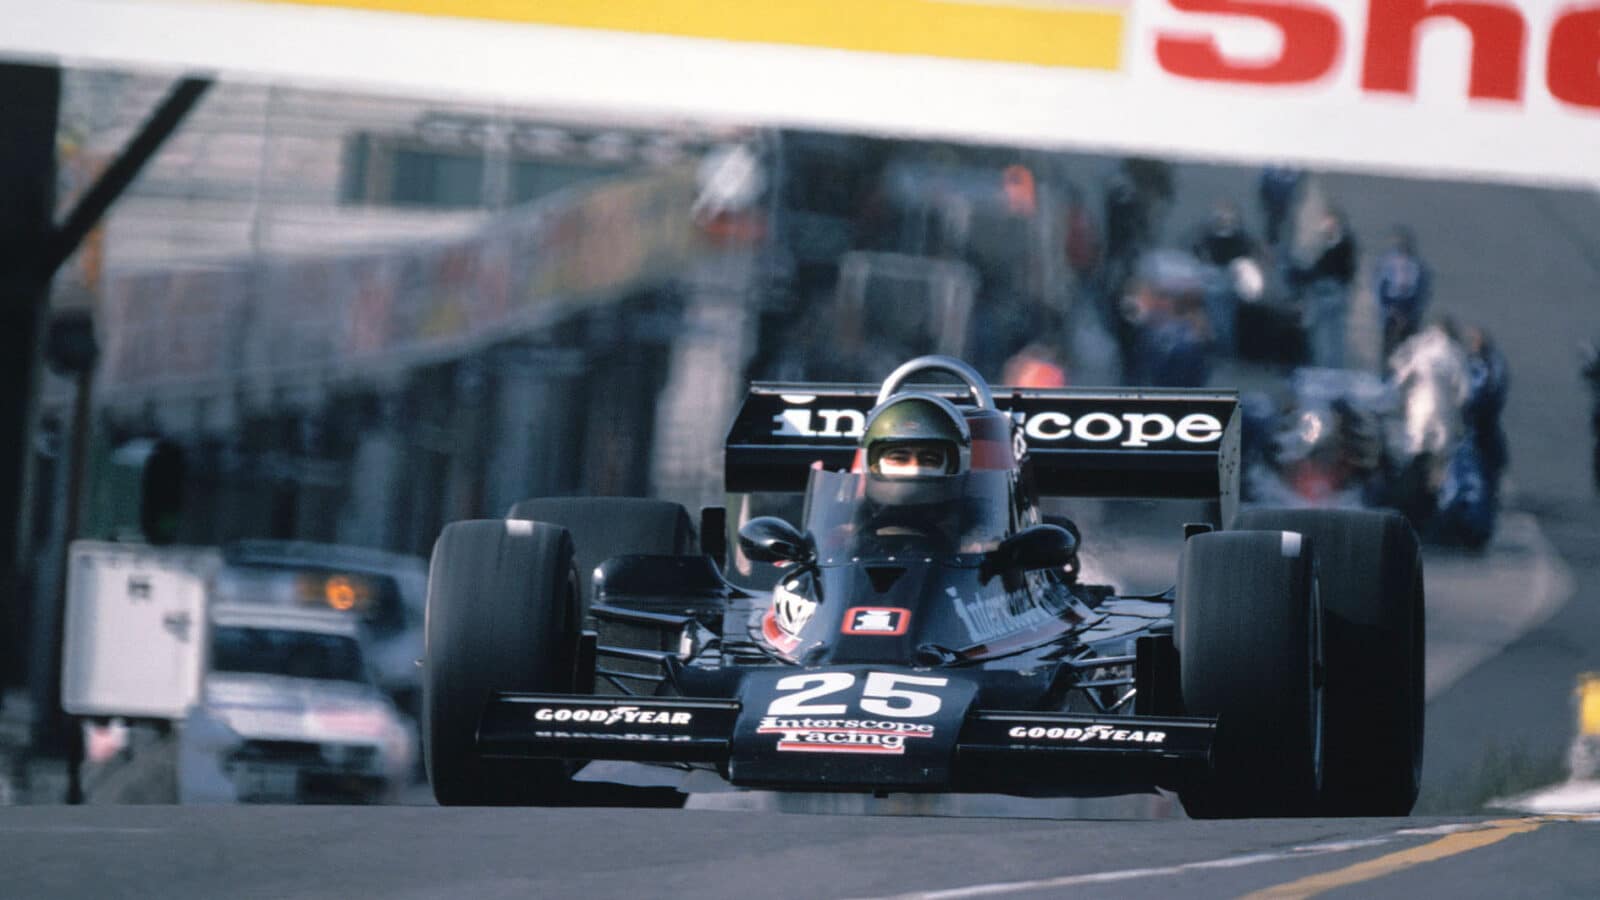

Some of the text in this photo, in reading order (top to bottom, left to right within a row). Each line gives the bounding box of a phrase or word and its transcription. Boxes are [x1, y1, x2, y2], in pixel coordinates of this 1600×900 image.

[771, 394, 1223, 446] incope
[767, 672, 948, 718] 25
[534, 706, 692, 725] GOODYEAR
[1008, 725, 1166, 743] GOODYEAR
